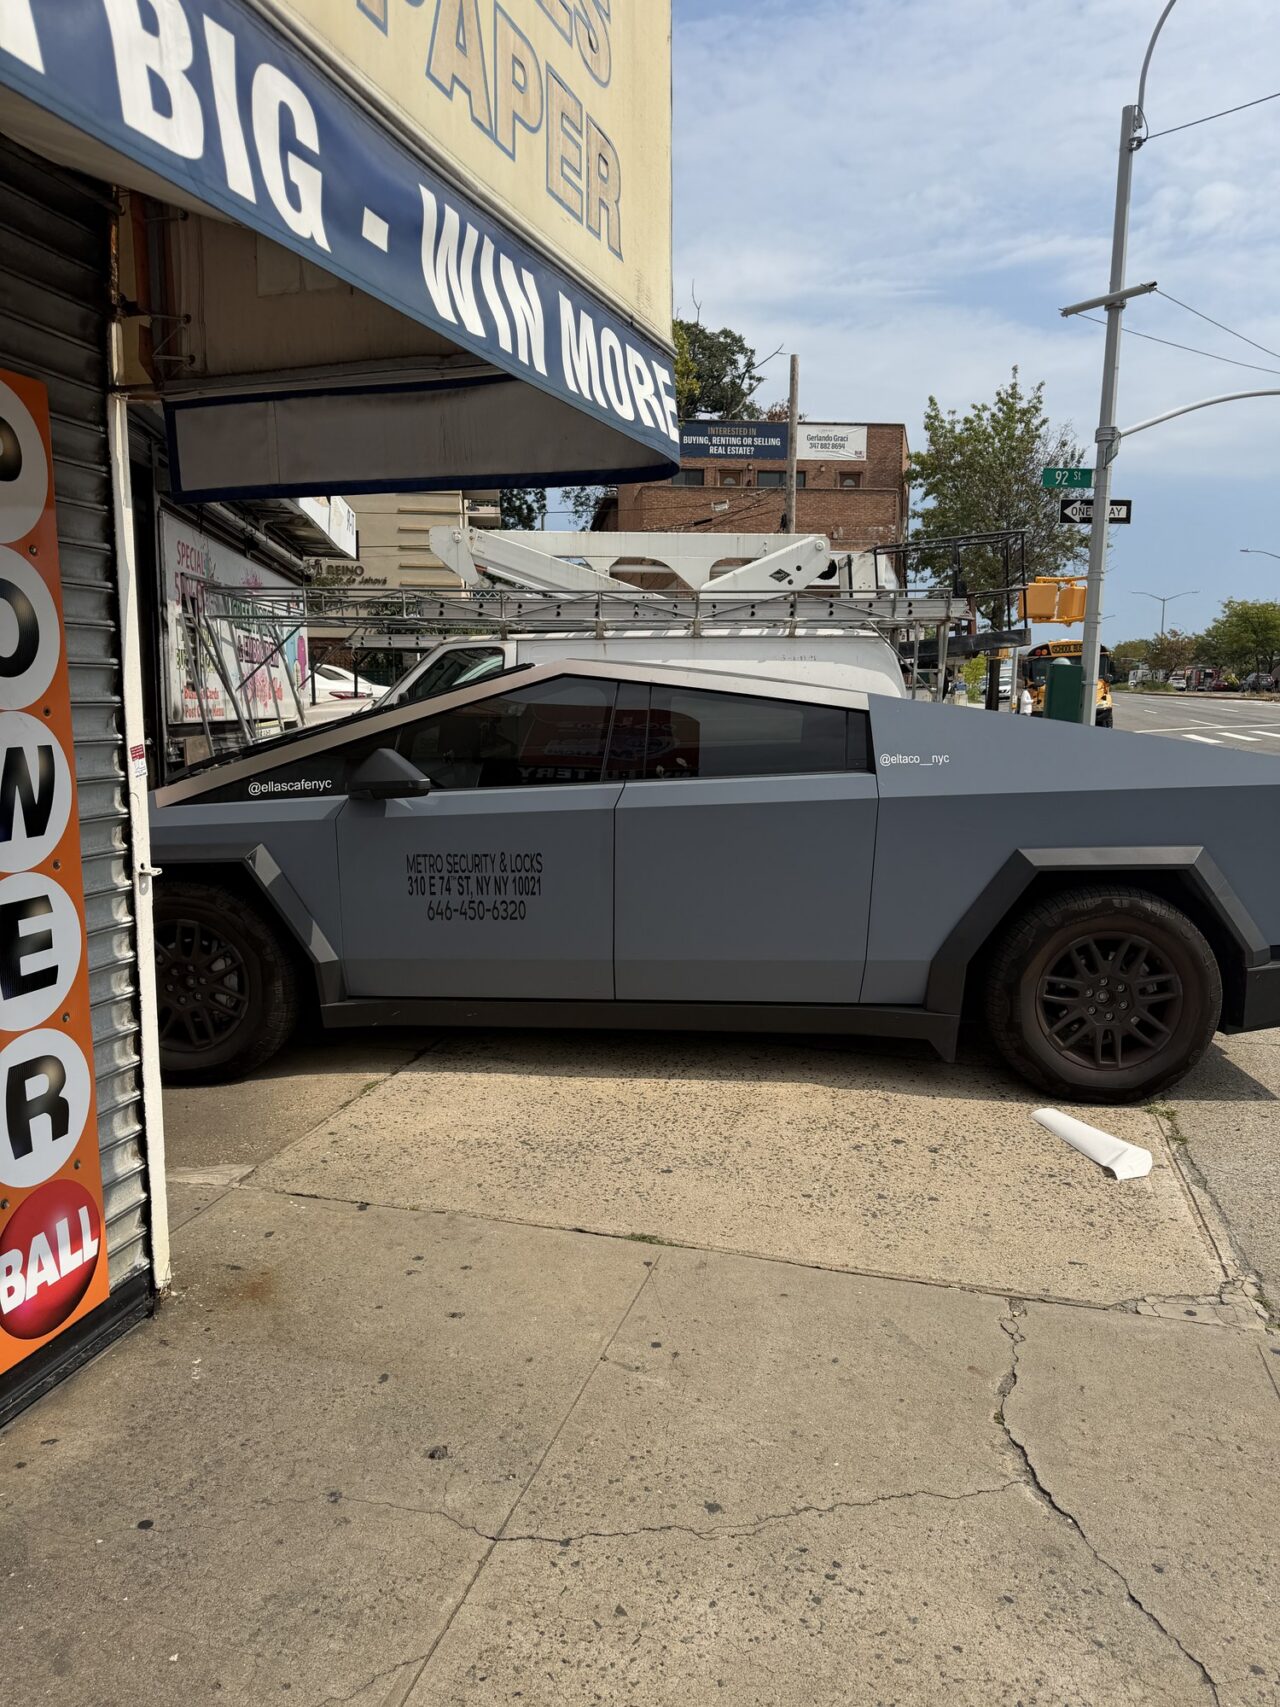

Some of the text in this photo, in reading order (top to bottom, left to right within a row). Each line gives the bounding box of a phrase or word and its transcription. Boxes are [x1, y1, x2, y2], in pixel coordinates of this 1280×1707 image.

[105, 0, 331, 252] BIG
[419, 184, 547, 377] WIN
[559, 291, 680, 443] MORE
[707, 427, 757, 436] INTERESTED IN
[806, 434, 832, 442] Gerlando
[683, 436, 781, 446] BUYING, RENTING OR SELLING
[709, 446, 755, 455] REAL ESTATE?
[1055, 470, 1081, 485] 92 St
[1071, 506, 1123, 517] ONE AY
[176, 540, 206, 577] SPECIAL
[248, 779, 332, 796] @ellascafenyc
[406, 852, 543, 874] METRO SECURITY & LOCKS
[408, 876, 425, 896] 310
[429, 876, 436, 896] E
[457, 876, 474, 899] ST,
[476, 876, 491, 896] NY
[494, 876, 509, 896] NY
[512, 876, 542, 896] 10021
[427, 900, 526, 921] 646-450-6320
[0, 1206, 100, 1315] BALL
